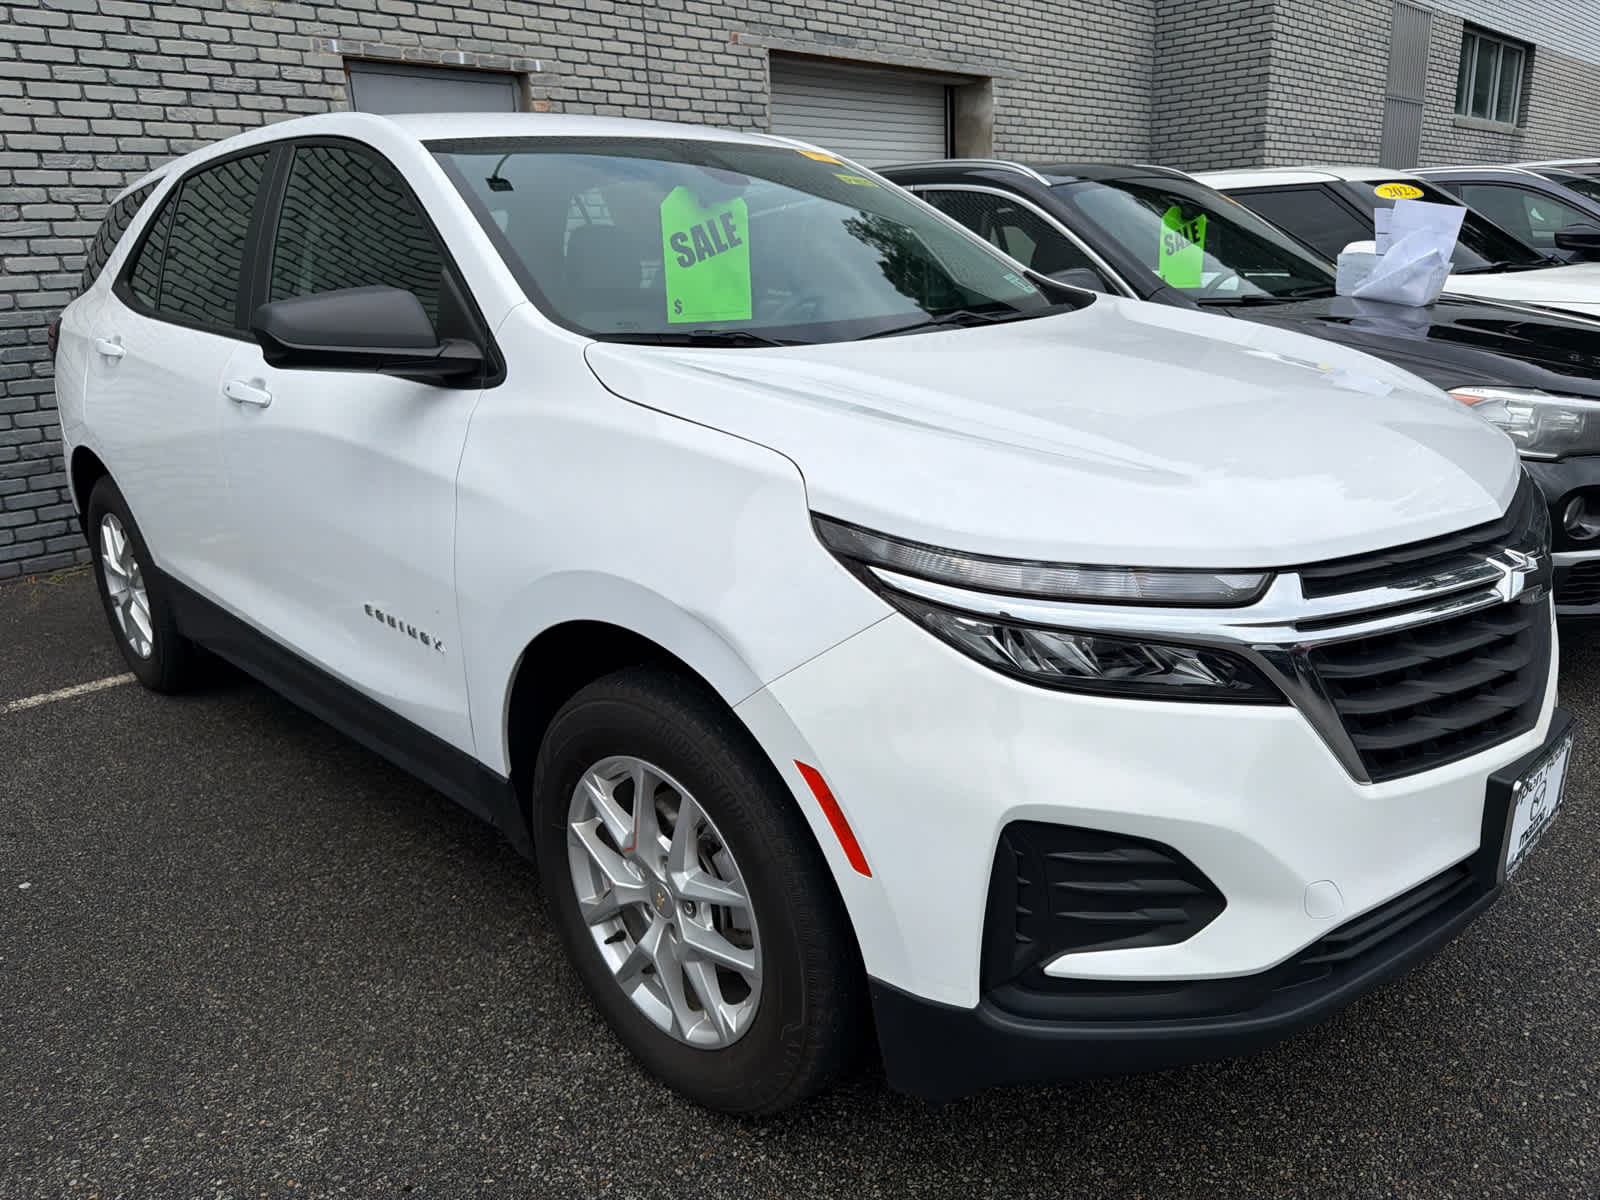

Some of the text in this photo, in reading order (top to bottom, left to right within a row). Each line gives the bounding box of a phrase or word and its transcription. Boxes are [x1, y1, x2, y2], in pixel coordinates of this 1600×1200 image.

[1384, 186, 1418, 198] 2023
[669, 211, 744, 269] SALE
[1164, 221, 1201, 256] SALE
[673, 298, 683, 315] $
[363, 603, 446, 656] EQUINOX
